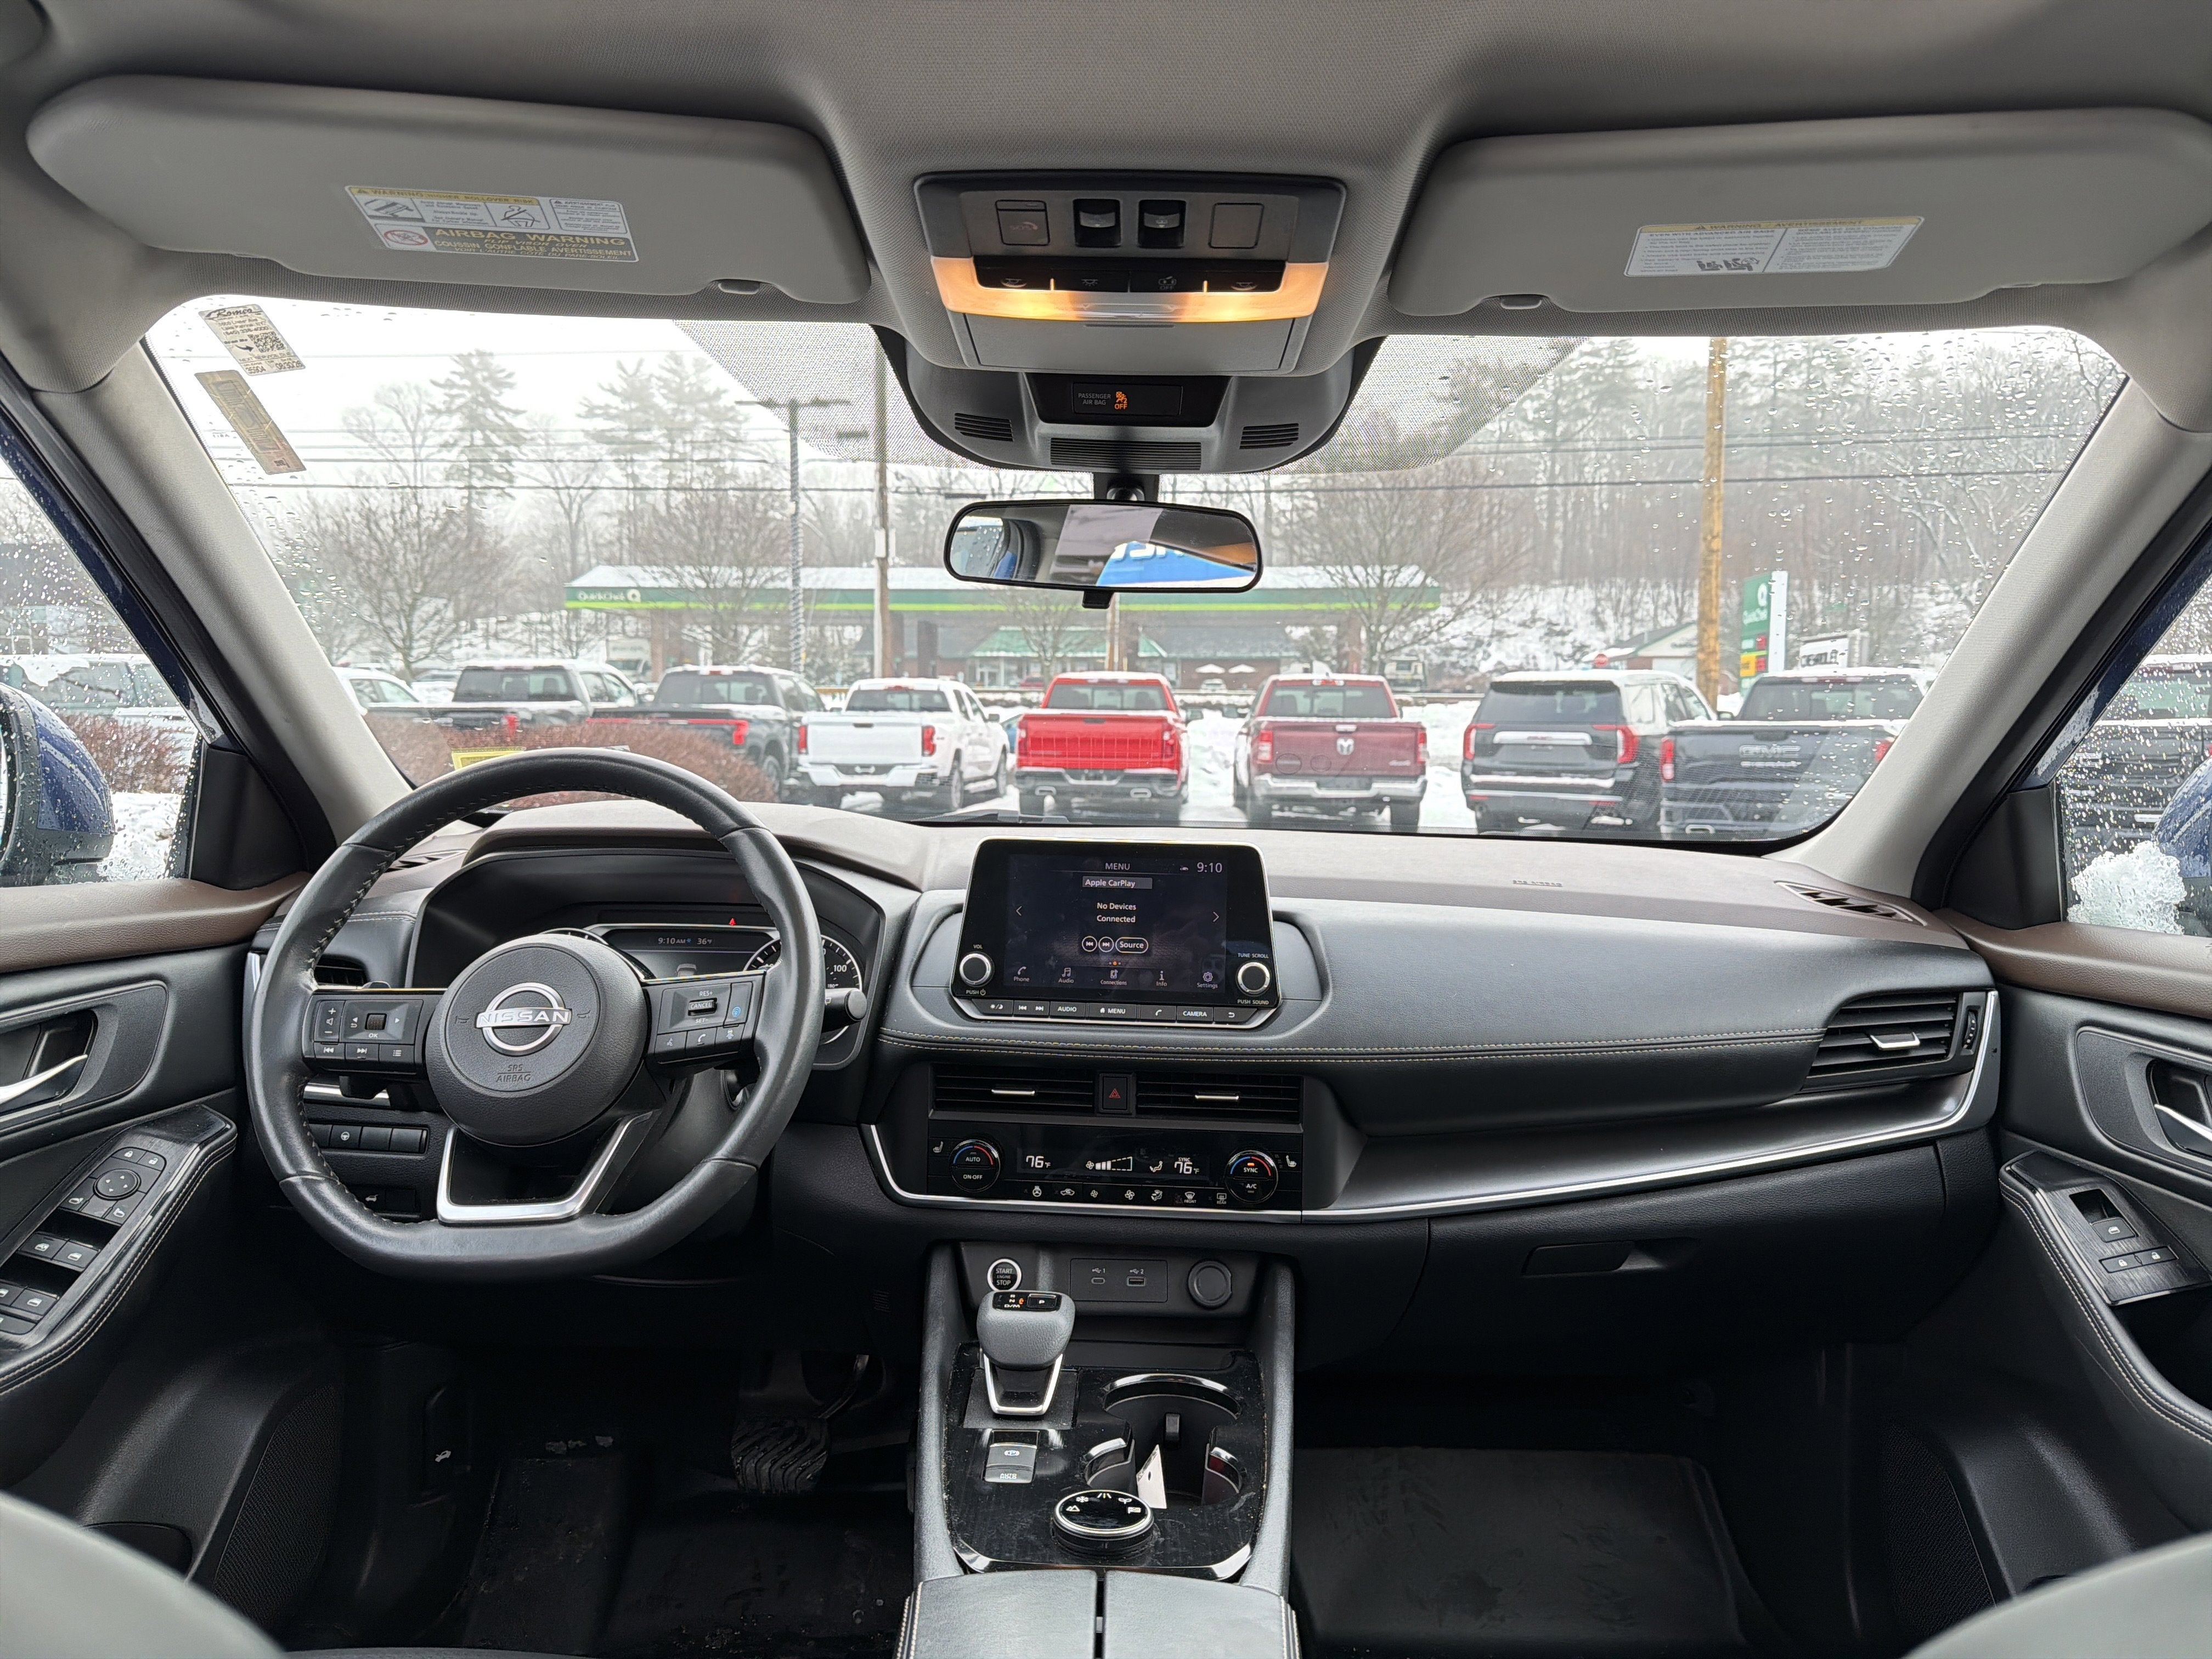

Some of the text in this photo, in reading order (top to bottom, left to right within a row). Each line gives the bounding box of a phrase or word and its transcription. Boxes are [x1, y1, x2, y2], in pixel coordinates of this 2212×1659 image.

[435, 228, 625, 246] AIRBAG WARNING
[434, 240, 631, 256] COUSSIN GONFLABLE AVERTISSEMENT
[1739, 744, 1801, 758] GMC
[1197, 862, 1223, 873] 9:10
[1085, 879, 1136, 888] Apple CarPlay
[1097, 915, 1136, 923] Connected
[479, 1010, 569, 1024] NISSAN
[507, 1064, 523, 1072] SRS
[495, 1074, 532, 1083] AIRBAG
